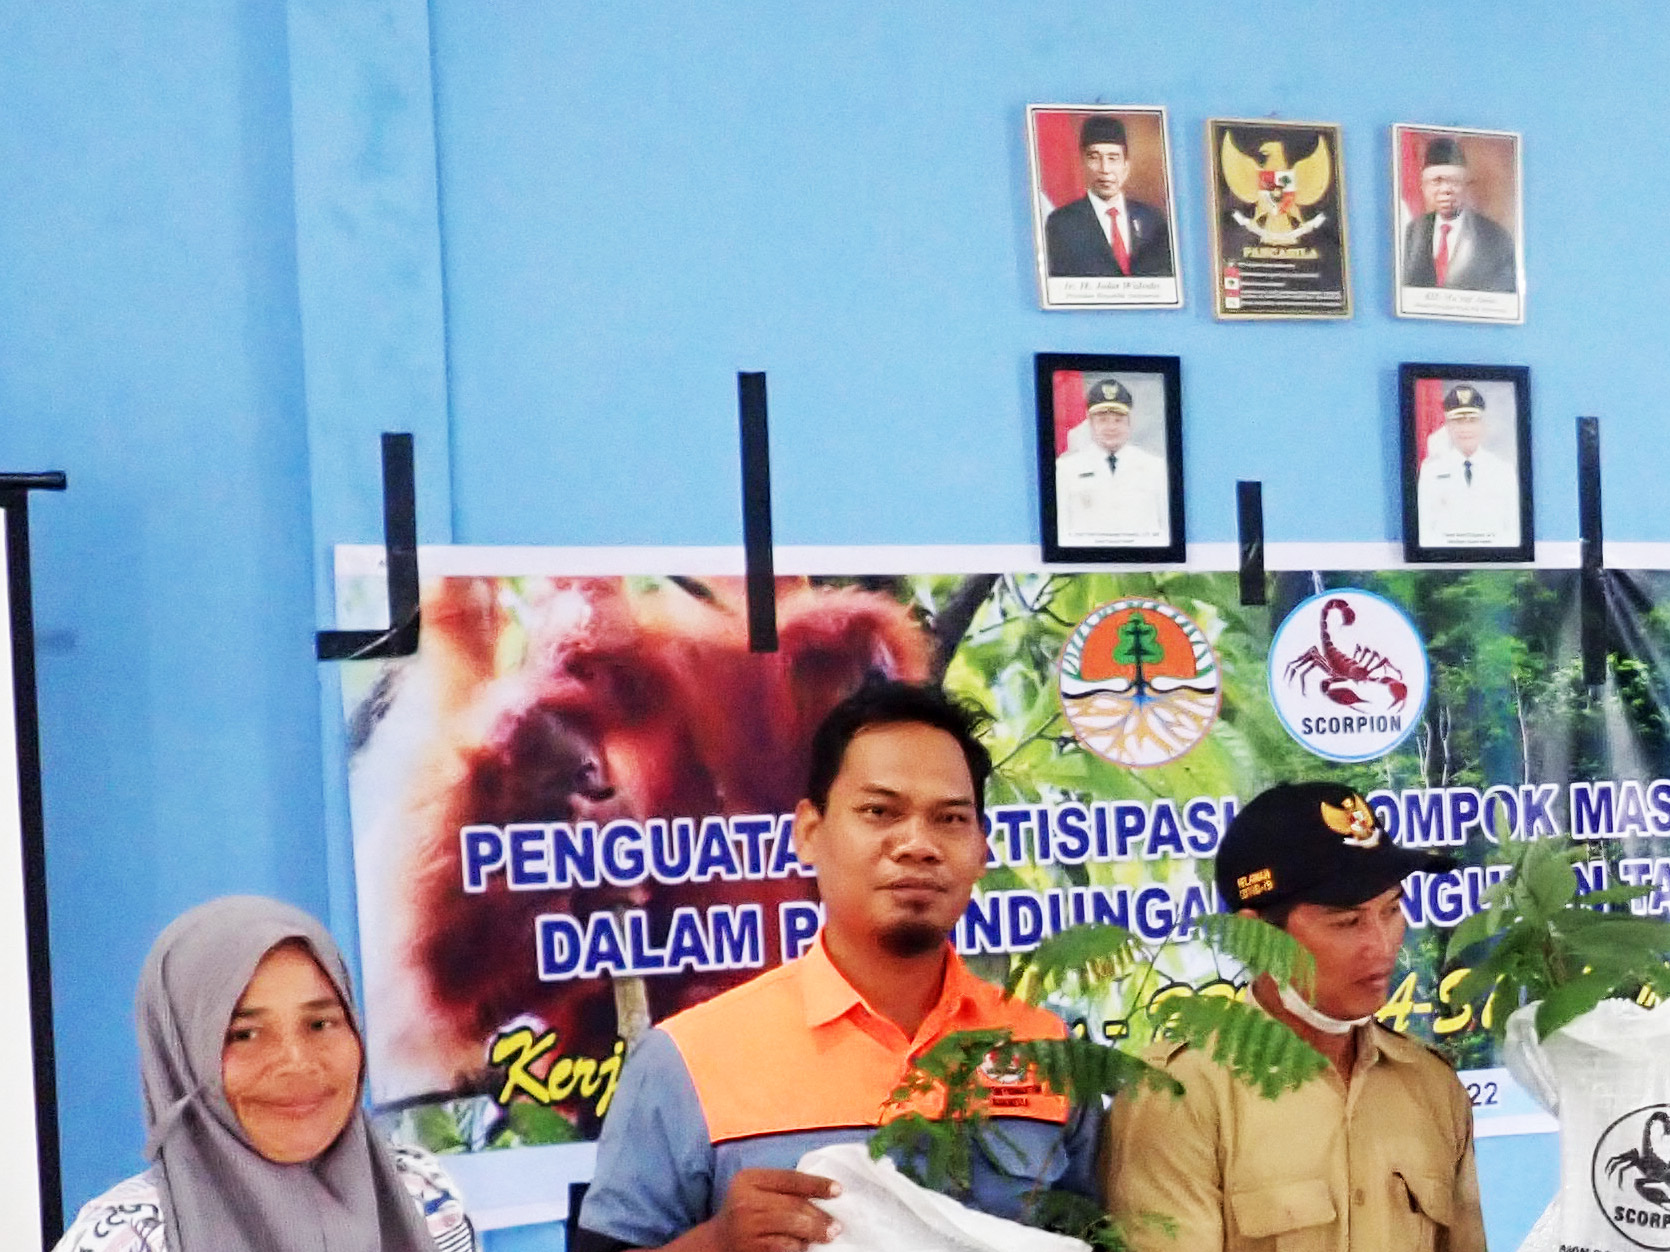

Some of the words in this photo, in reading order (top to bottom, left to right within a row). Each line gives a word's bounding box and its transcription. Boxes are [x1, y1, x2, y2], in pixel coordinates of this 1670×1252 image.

[1301, 714, 1402, 735] SCORPION
[460, 813, 820, 894] PENGUATA
[1366, 784, 1560, 848] OMPOK
[534, 902, 765, 981] DALAM
[490, 1028, 627, 1118] Kerj
[1465, 1081, 1500, 1108] 22
